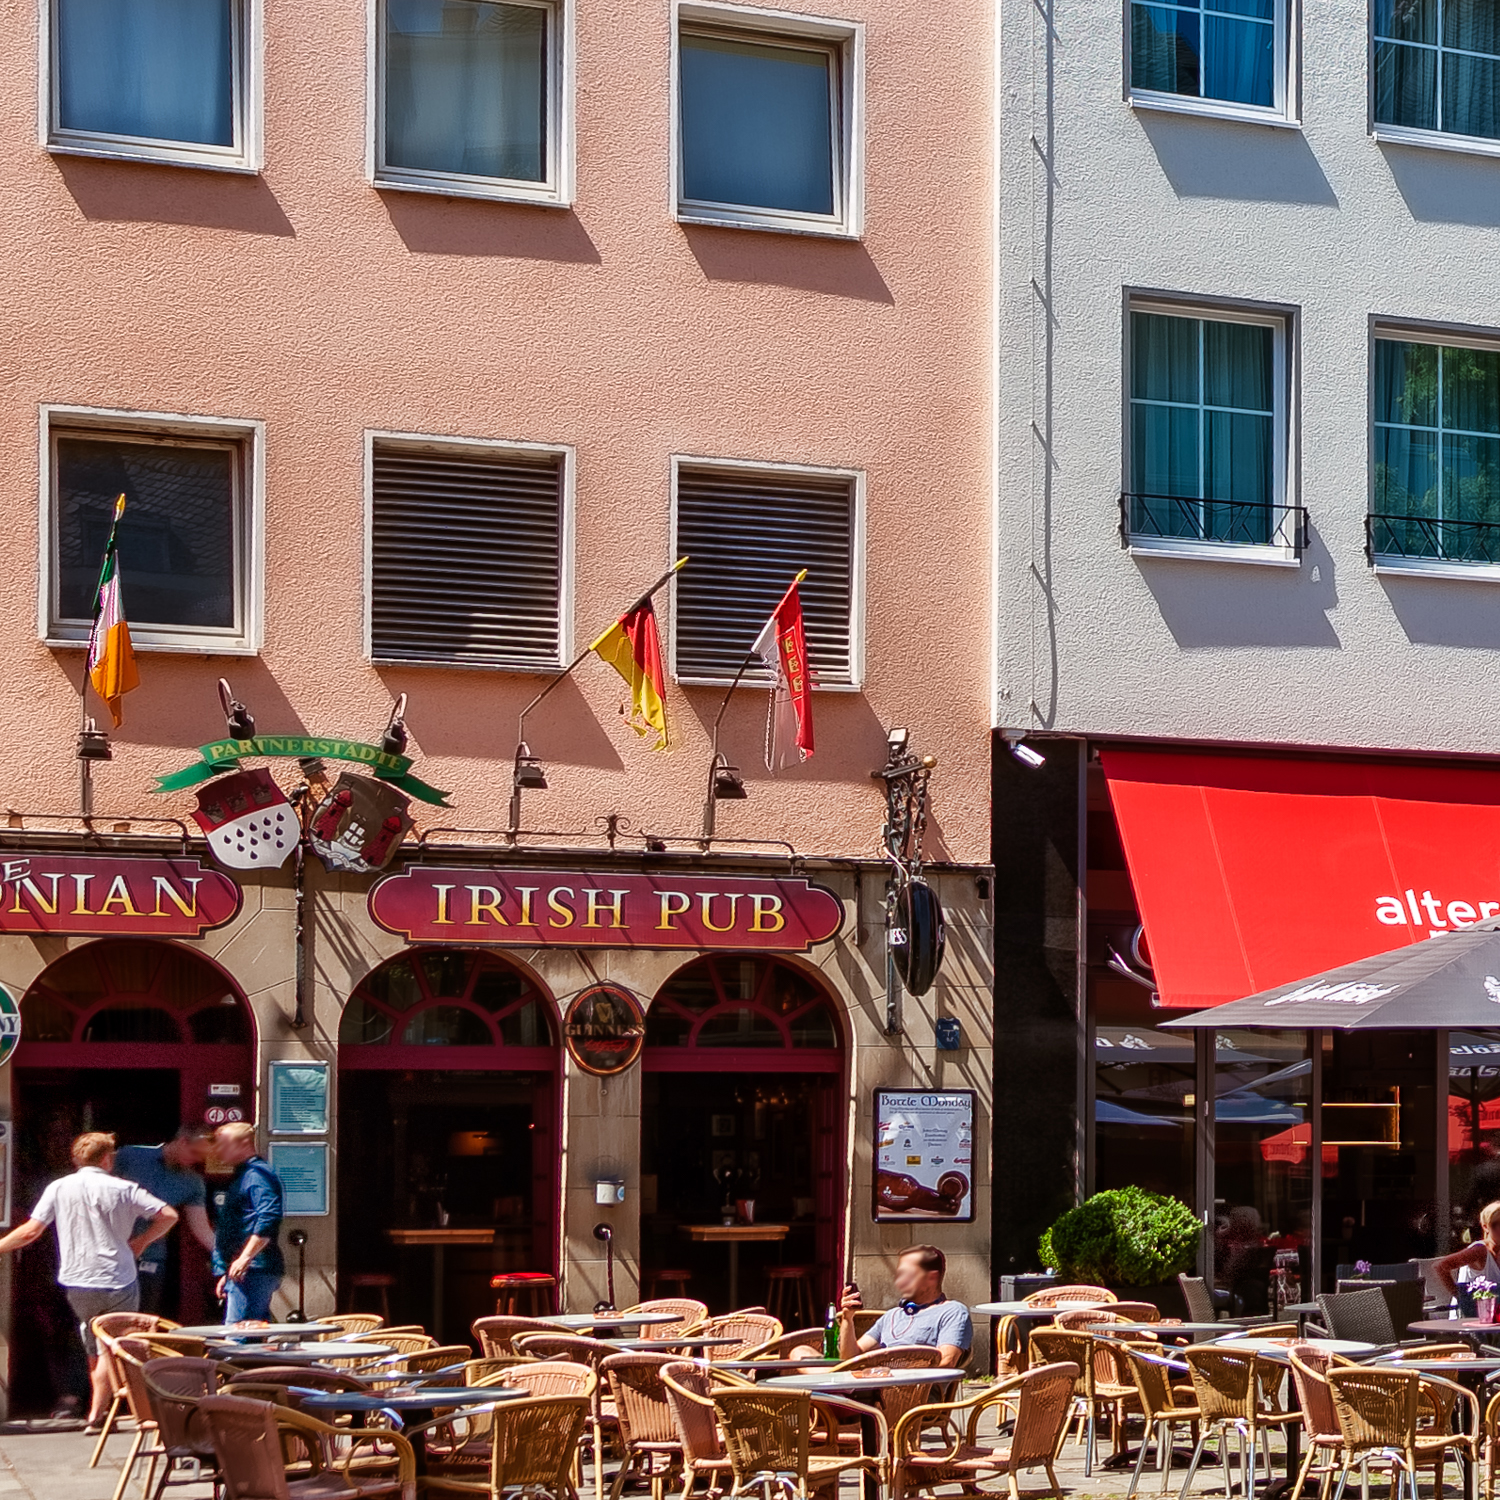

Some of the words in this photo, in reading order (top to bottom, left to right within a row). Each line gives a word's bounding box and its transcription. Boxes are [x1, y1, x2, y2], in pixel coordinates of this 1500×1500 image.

[208, 737, 405, 771] PARTNERSTÄDTE
[430, 883, 631, 928] IRISH
[653, 890, 786, 934] PUB
[1375, 889, 1500, 929] alter
[564, 1023, 646, 1037] GUINNESS
[880, 1094, 917, 1107] Bottle
[920, 1095, 972, 1110] Monday
